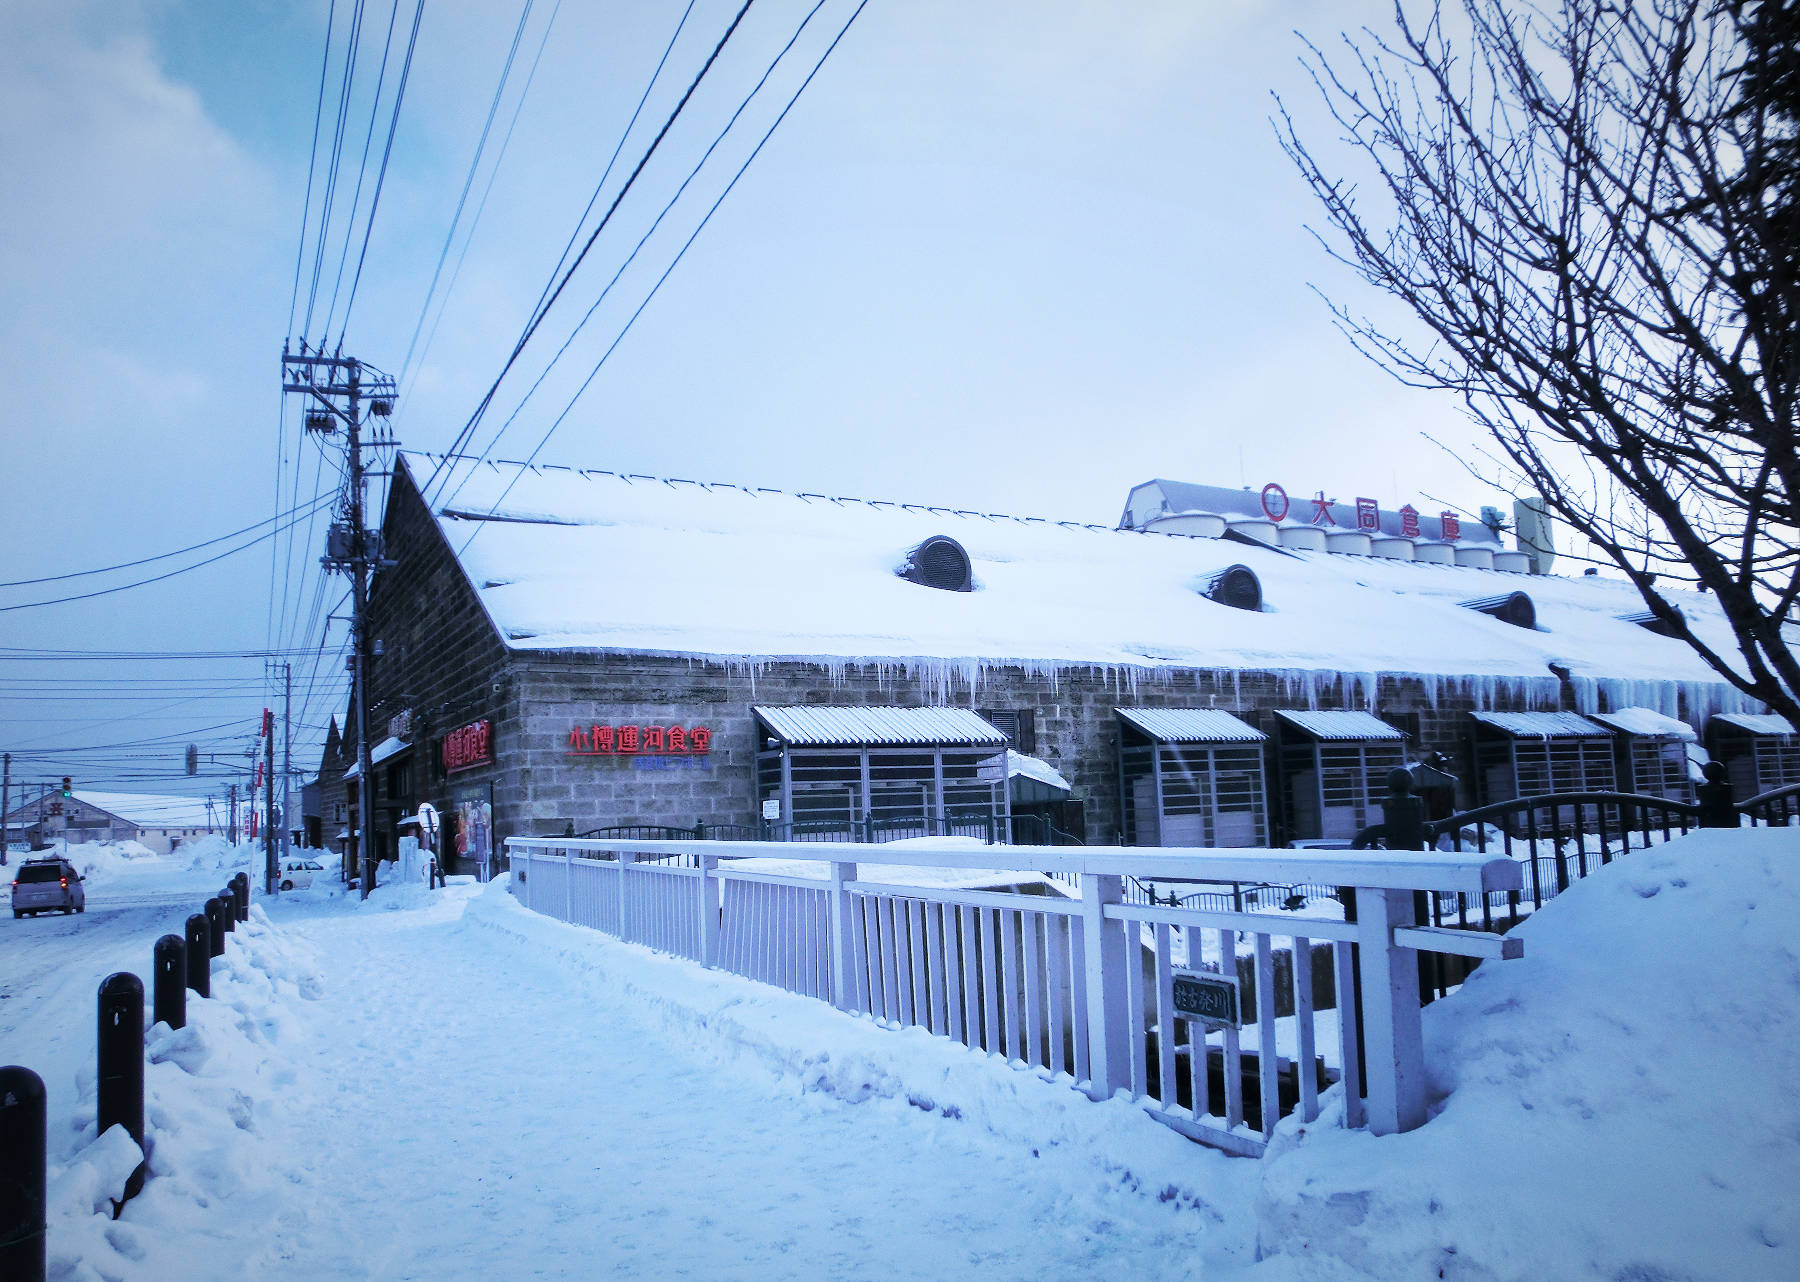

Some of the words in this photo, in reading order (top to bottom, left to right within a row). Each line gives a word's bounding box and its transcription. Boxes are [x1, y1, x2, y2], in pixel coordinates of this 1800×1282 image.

[1312, 490, 1462, 542] 大同倉庫
[568, 725, 712, 752] 小樽運河食堂
